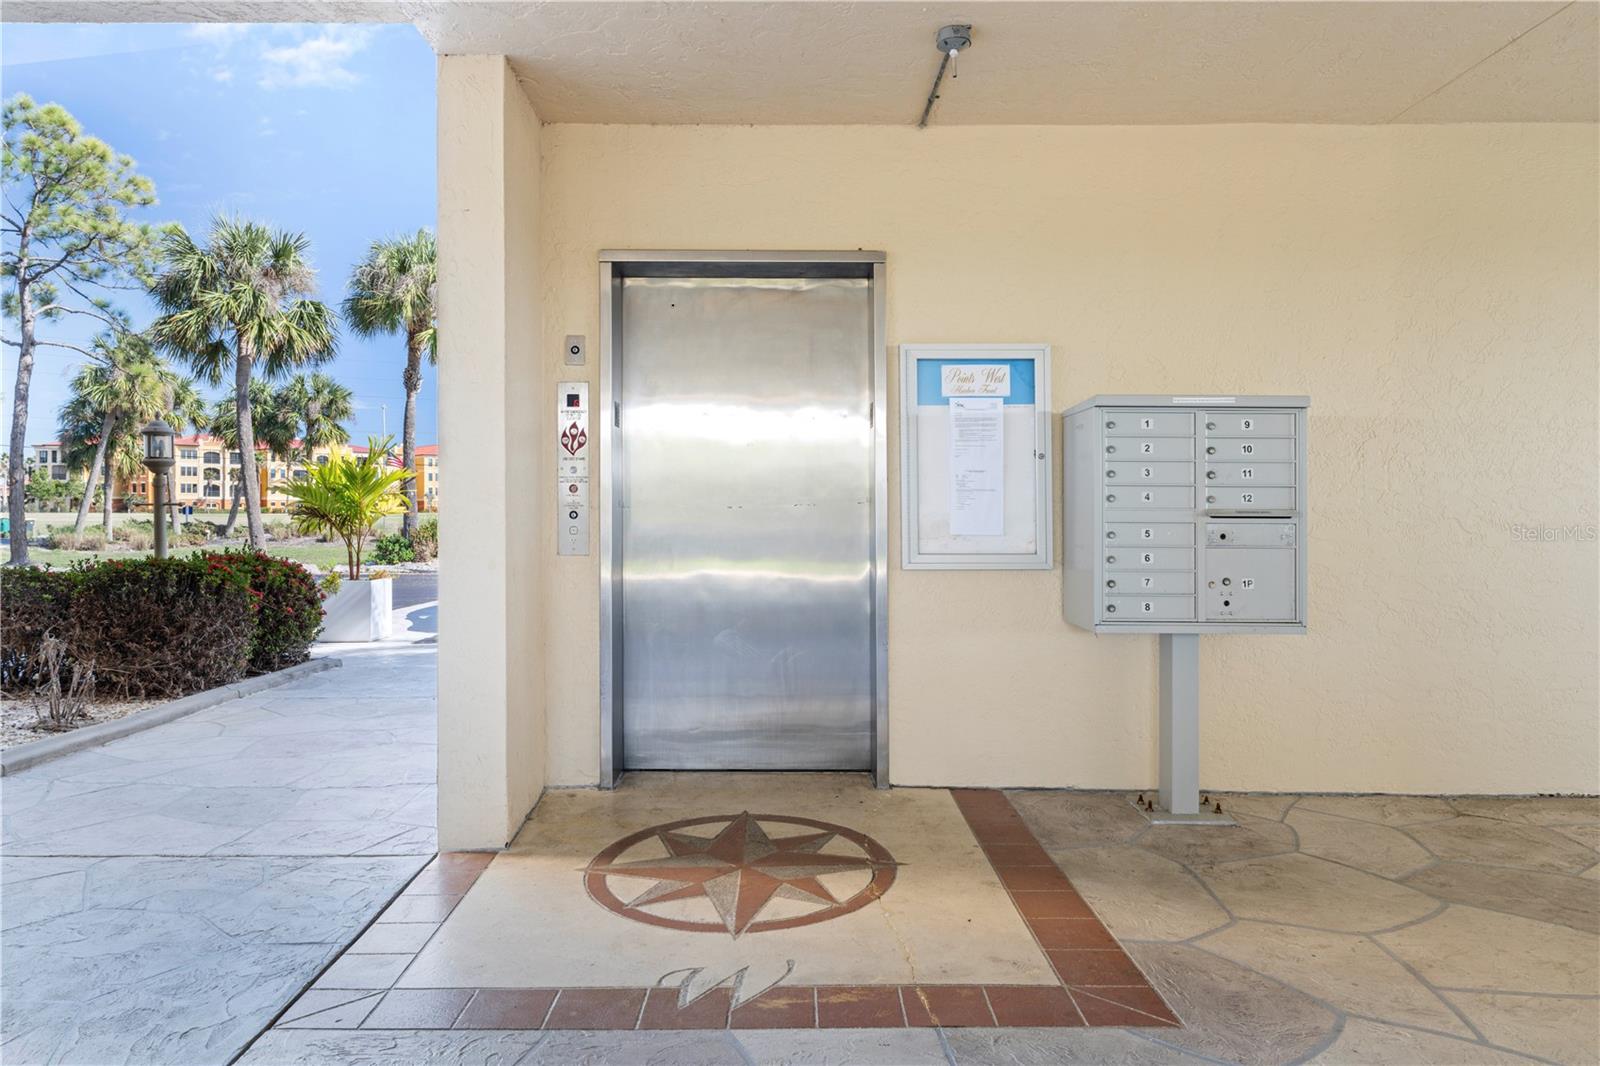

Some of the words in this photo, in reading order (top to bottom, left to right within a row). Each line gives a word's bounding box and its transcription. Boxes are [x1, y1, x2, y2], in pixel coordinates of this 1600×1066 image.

[945, 367, 975, 384] Points
[981, 367, 1007, 384] West
[1144, 420, 1150, 428] 1
[1244, 421, 1251, 429] 9
[1144, 444, 1151, 452] 2
[1242, 445, 1253, 453] 10
[1144, 469, 1151, 477] 3
[1242, 470, 1252, 478] 11
[1144, 493, 1150, 501] 4
[1242, 495, 1253, 503] 12
[1144, 530, 1151, 538] 5
[1144, 554, 1151, 562] 6
[1144, 579, 1151, 587] 7
[1242, 580, 1253, 588] 1P
[1144, 603, 1151, 611] 8
